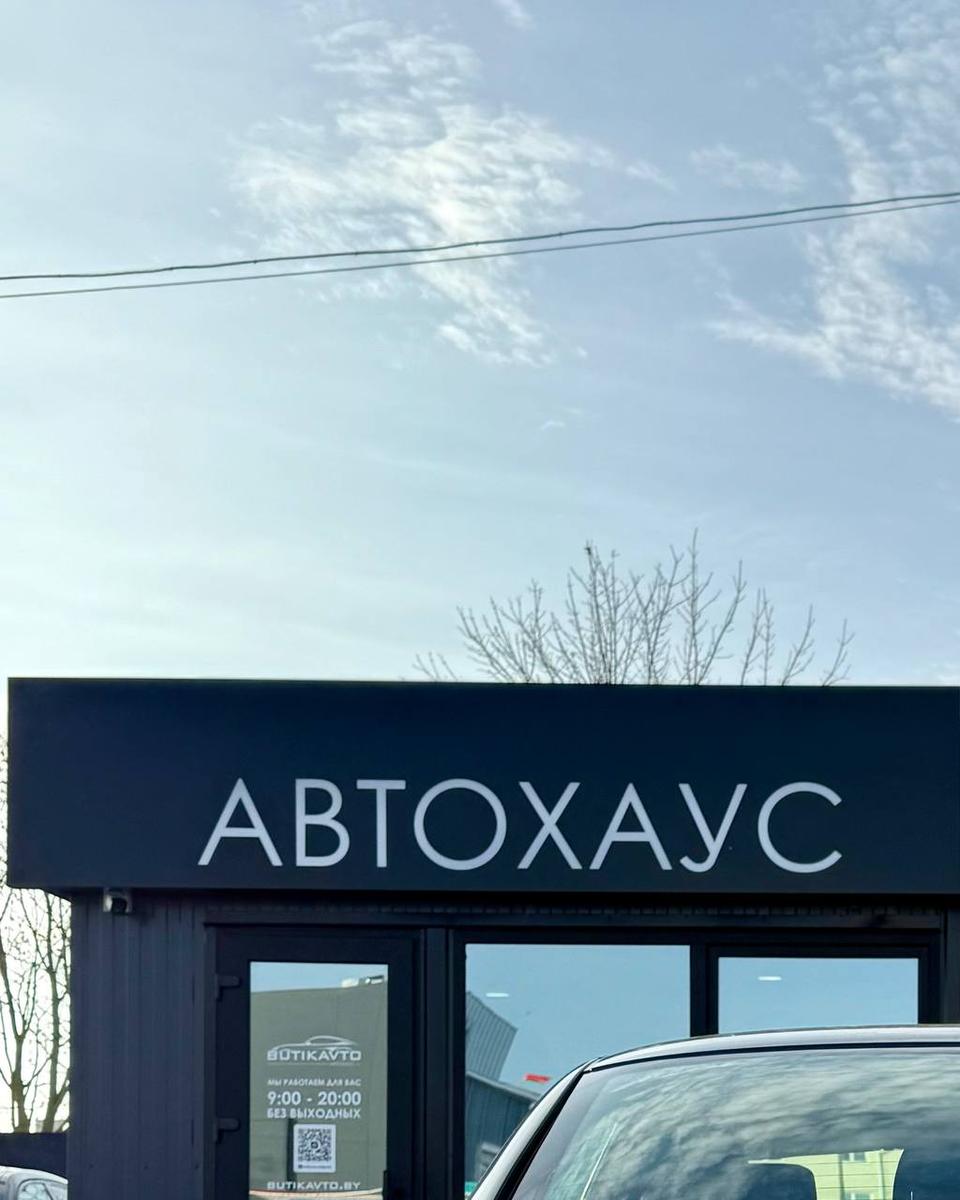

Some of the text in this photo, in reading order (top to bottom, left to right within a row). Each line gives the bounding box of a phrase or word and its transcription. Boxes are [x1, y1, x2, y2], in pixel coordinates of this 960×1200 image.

[197, 778, 842, 873] АВТОХАУС
[266, 1049, 362, 1061] BUTIKAVTO
[267, 1091, 302, 1106] 9:00
[317, 1091, 362, 1106] 20:00
[267, 1108, 361, 1119] БЕЗ ВЫХОДНЫХ
[266, 1181, 361, 1191] BUTIKAVTO.BY
